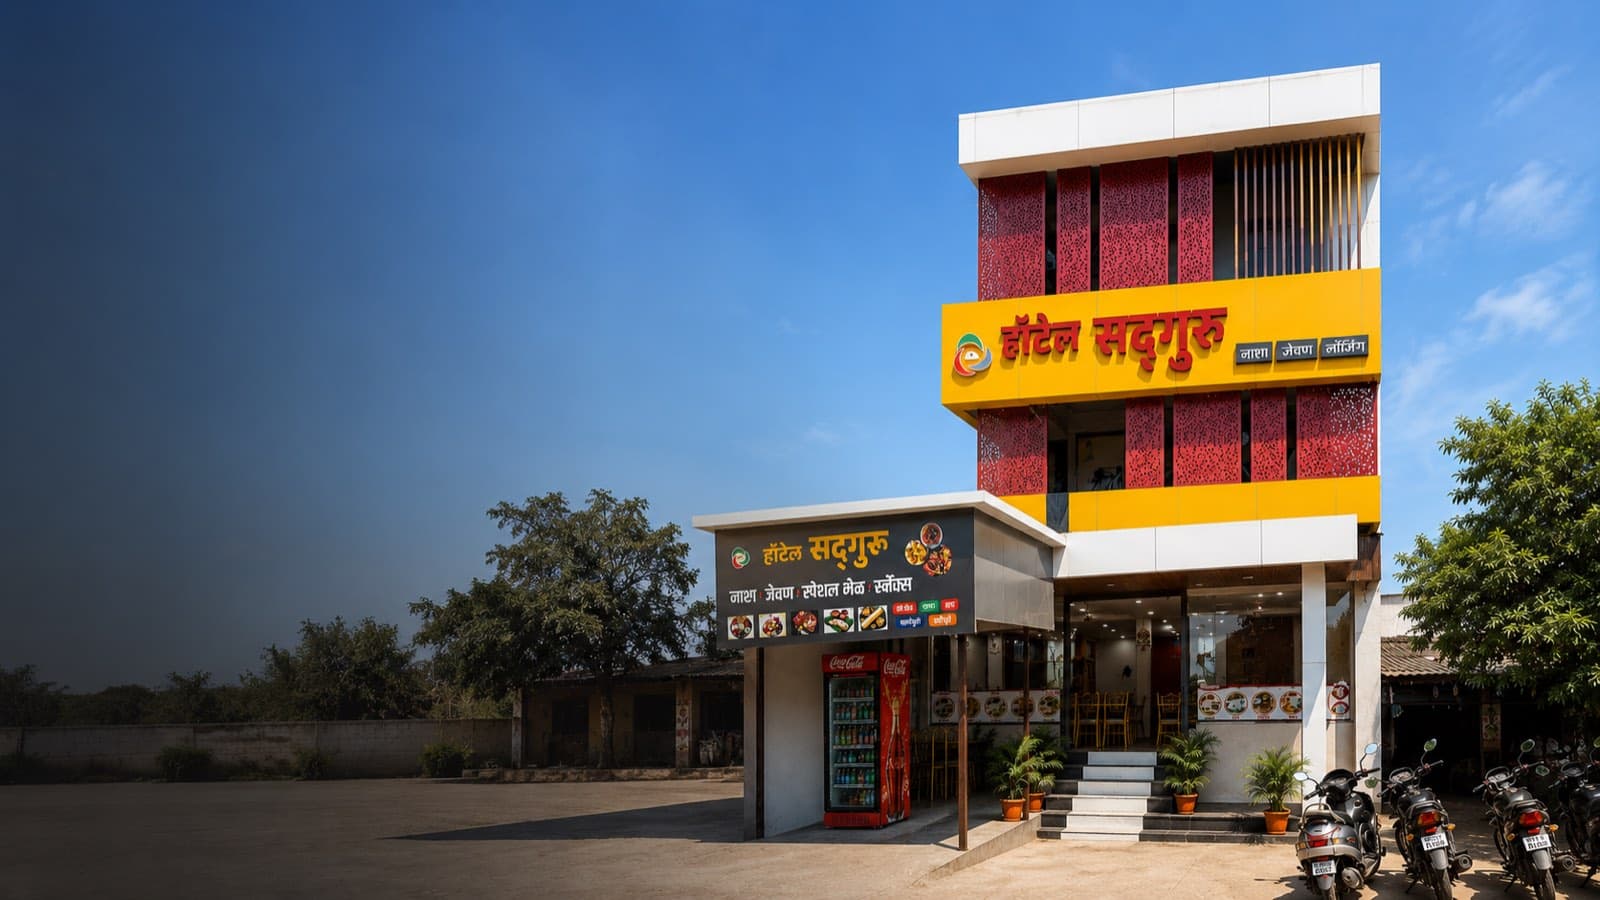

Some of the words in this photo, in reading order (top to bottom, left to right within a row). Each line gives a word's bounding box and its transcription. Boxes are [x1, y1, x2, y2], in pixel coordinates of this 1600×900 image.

[1001, 313, 1081, 359] हॉटेल
[762, 542, 803, 565] हॉटेल
[764, 583, 795, 601] जेवण
